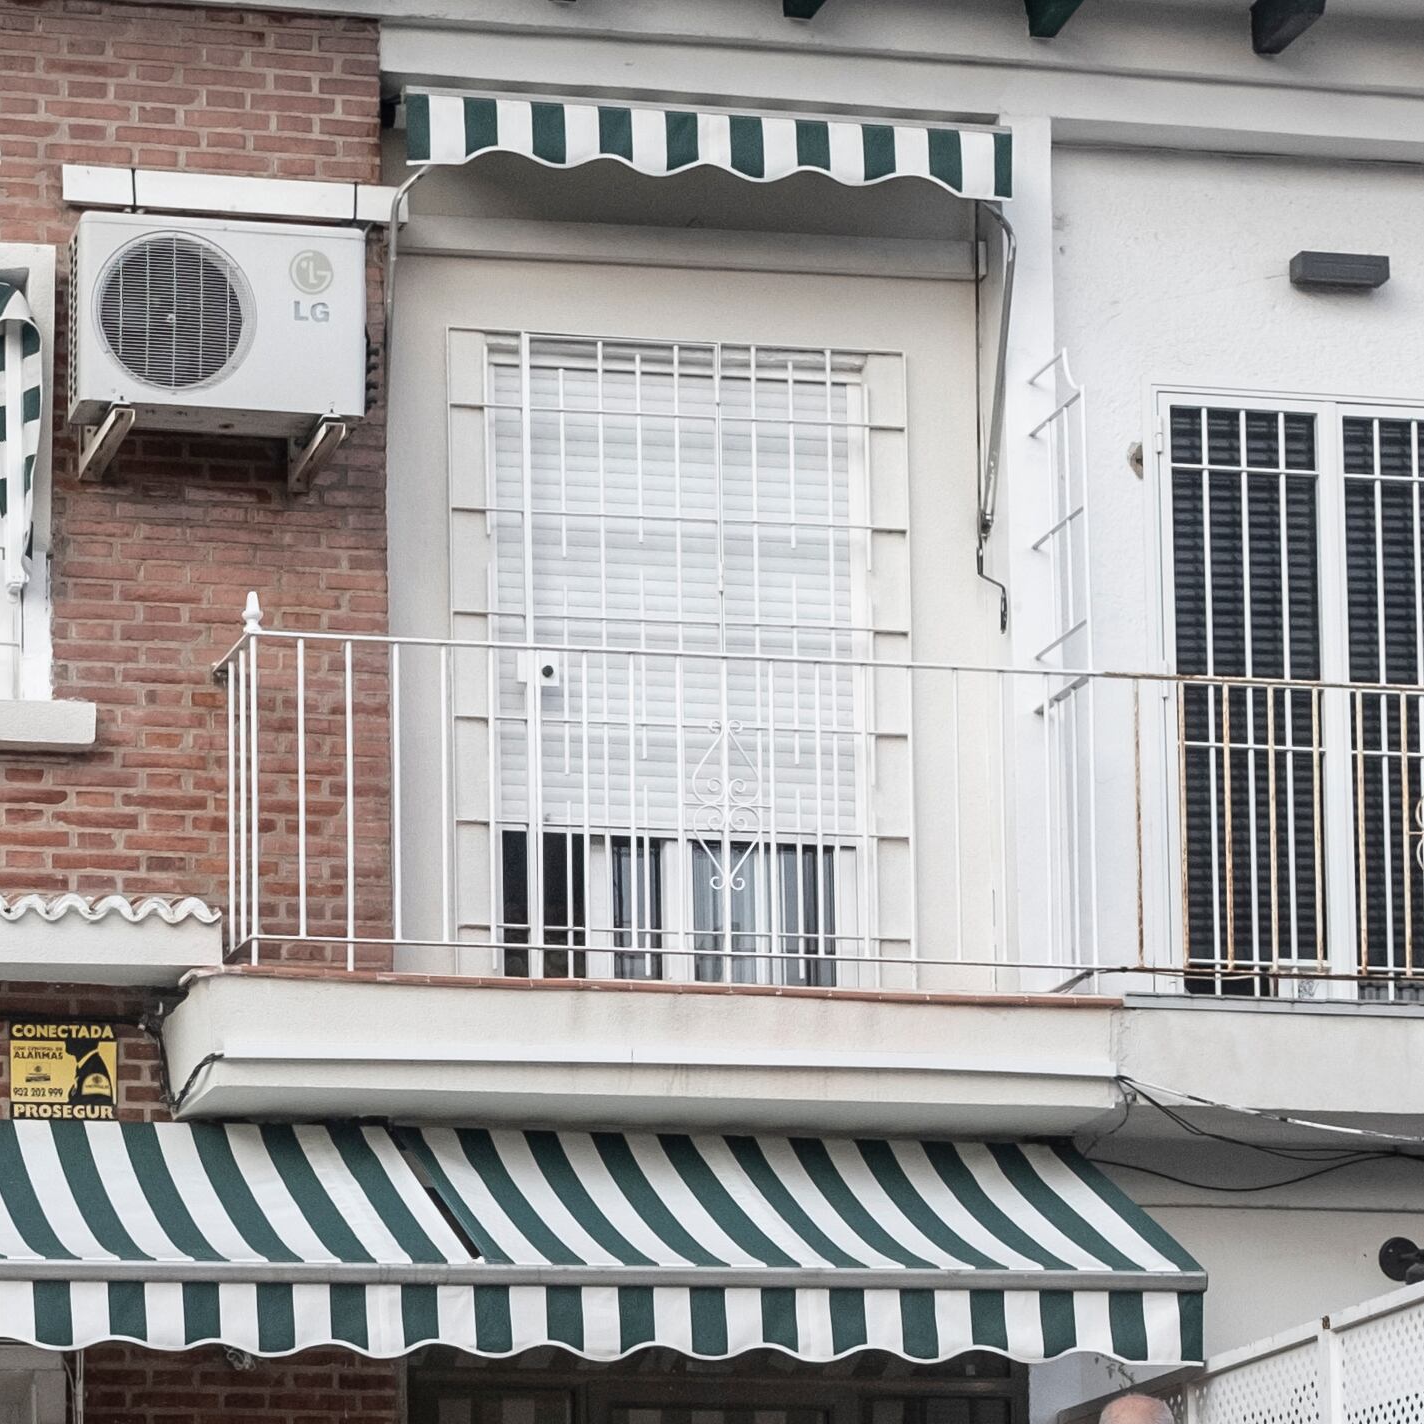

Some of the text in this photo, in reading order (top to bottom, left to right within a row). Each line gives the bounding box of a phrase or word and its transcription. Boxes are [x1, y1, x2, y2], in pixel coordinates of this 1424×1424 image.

[294, 300, 330, 323] LG
[12, 1024, 114, 1038] CONECTADA
[14, 1051, 63, 1060] ALARMAS
[14, 1087, 63, 1097] 902 202 999
[13, 1103, 114, 1119] PROSEGUR
